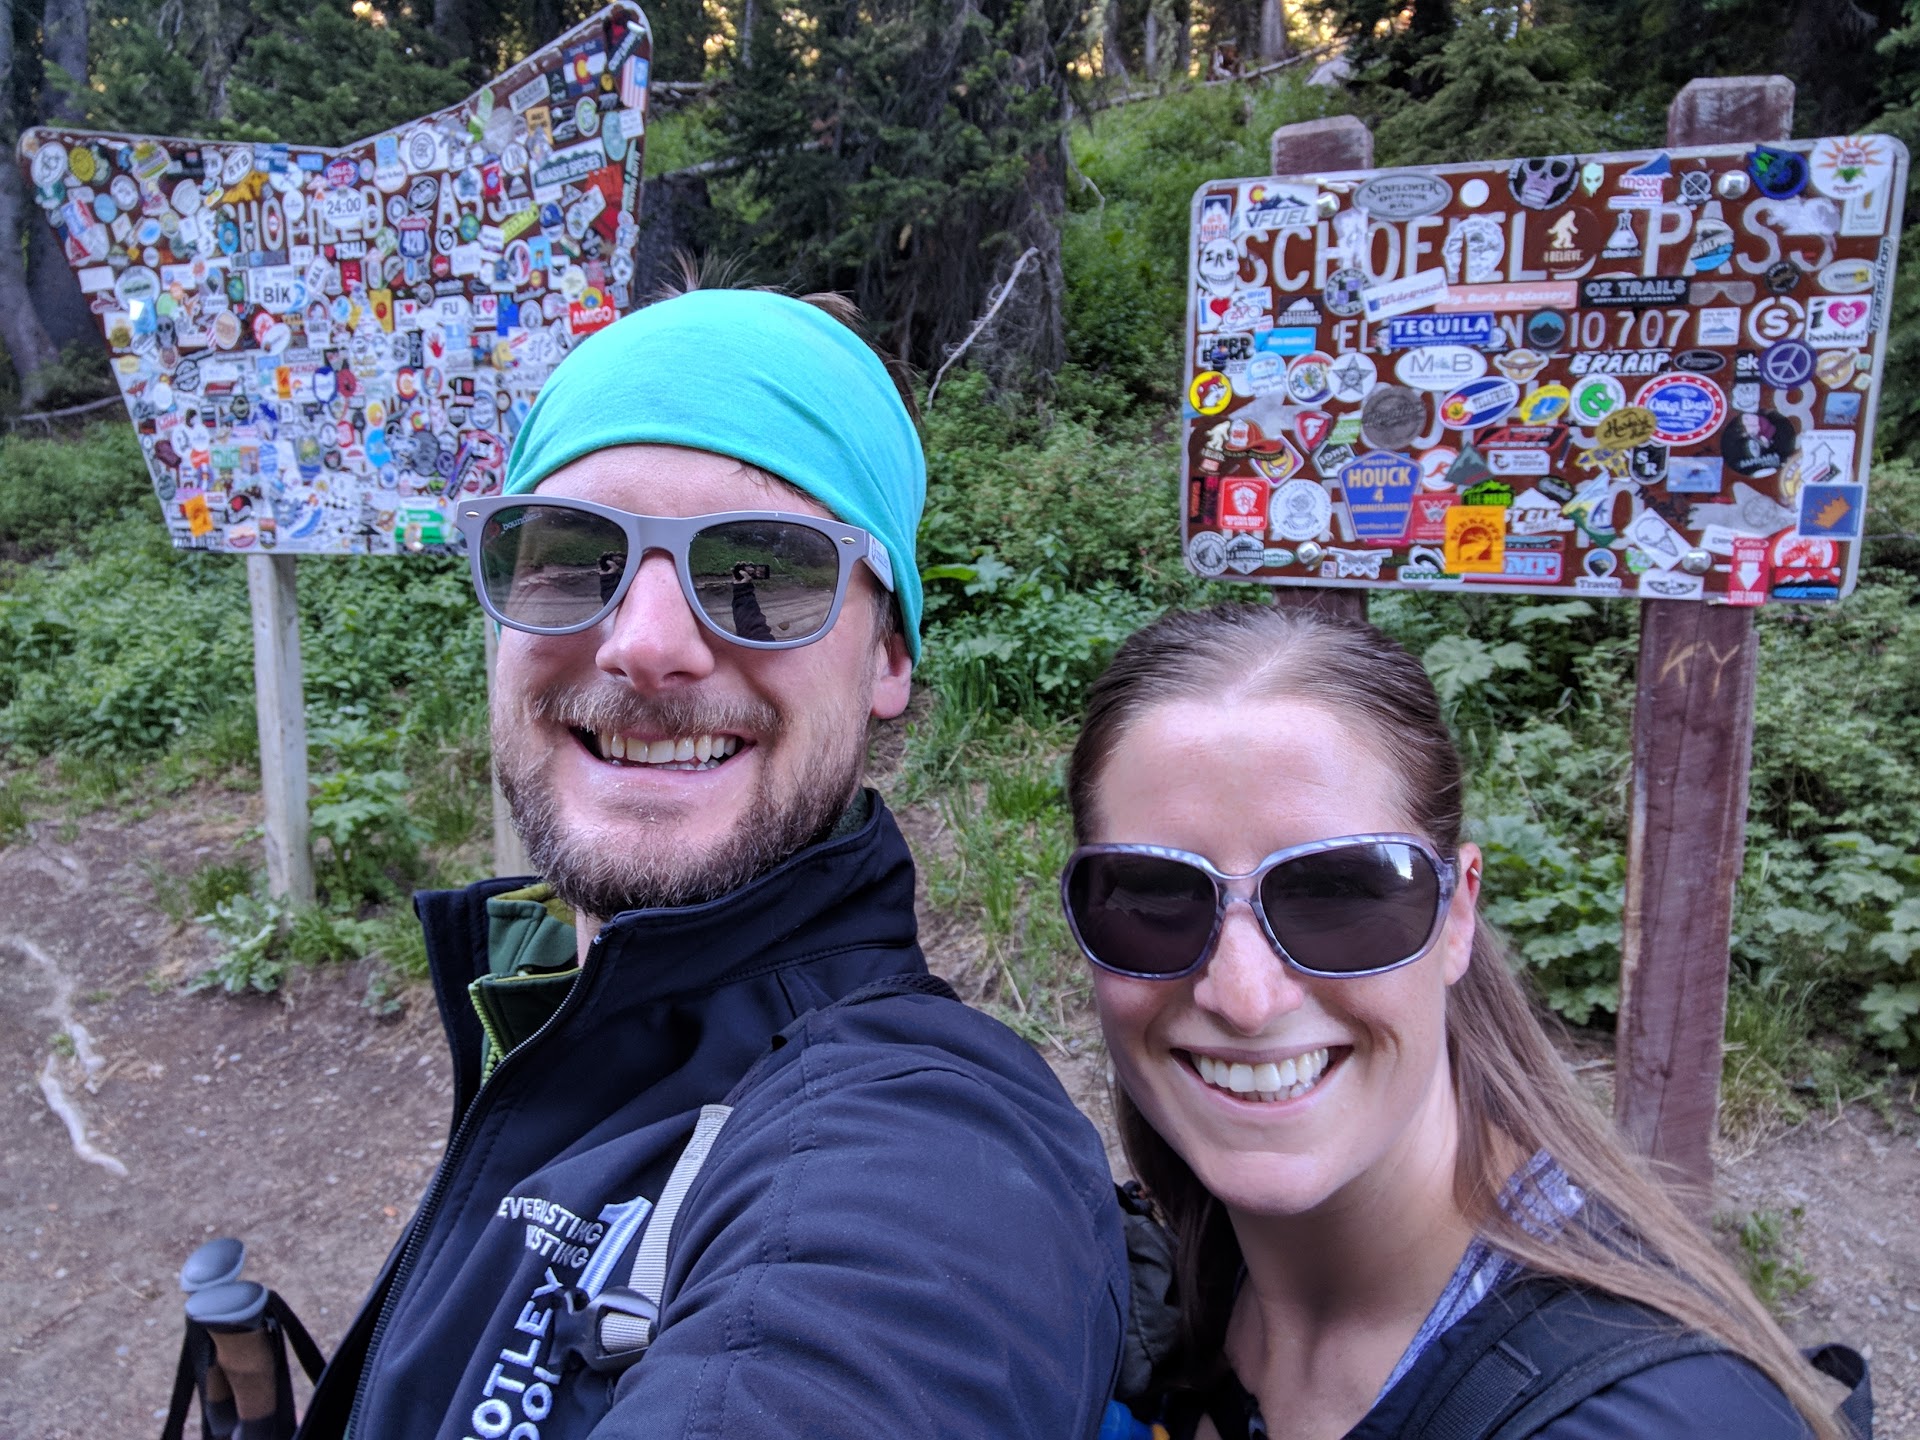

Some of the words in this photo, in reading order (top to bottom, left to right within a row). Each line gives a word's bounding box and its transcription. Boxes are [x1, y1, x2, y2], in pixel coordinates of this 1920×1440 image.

[1368, 181, 1441, 196] SUNFLOWER
[327, 197, 361, 215] 24:00
[1246, 207, 1311, 228] VFUEL
[1585, 281, 1613, 297] OZ
[1618, 279, 1687, 296] TRAILS
[442, 302, 459, 315] FU
[573, 305, 613, 325] AMIGO
[1392, 317, 1490, 337] TEQUILA
[1568, 350, 1671, 375] BRAAAP
[1348, 466, 1412, 489] HOUCK
[1373, 489, 1384, 502] 4
[1579, 579, 1619, 590] Travel
[462, 1266, 564, 1440] OTLEY
